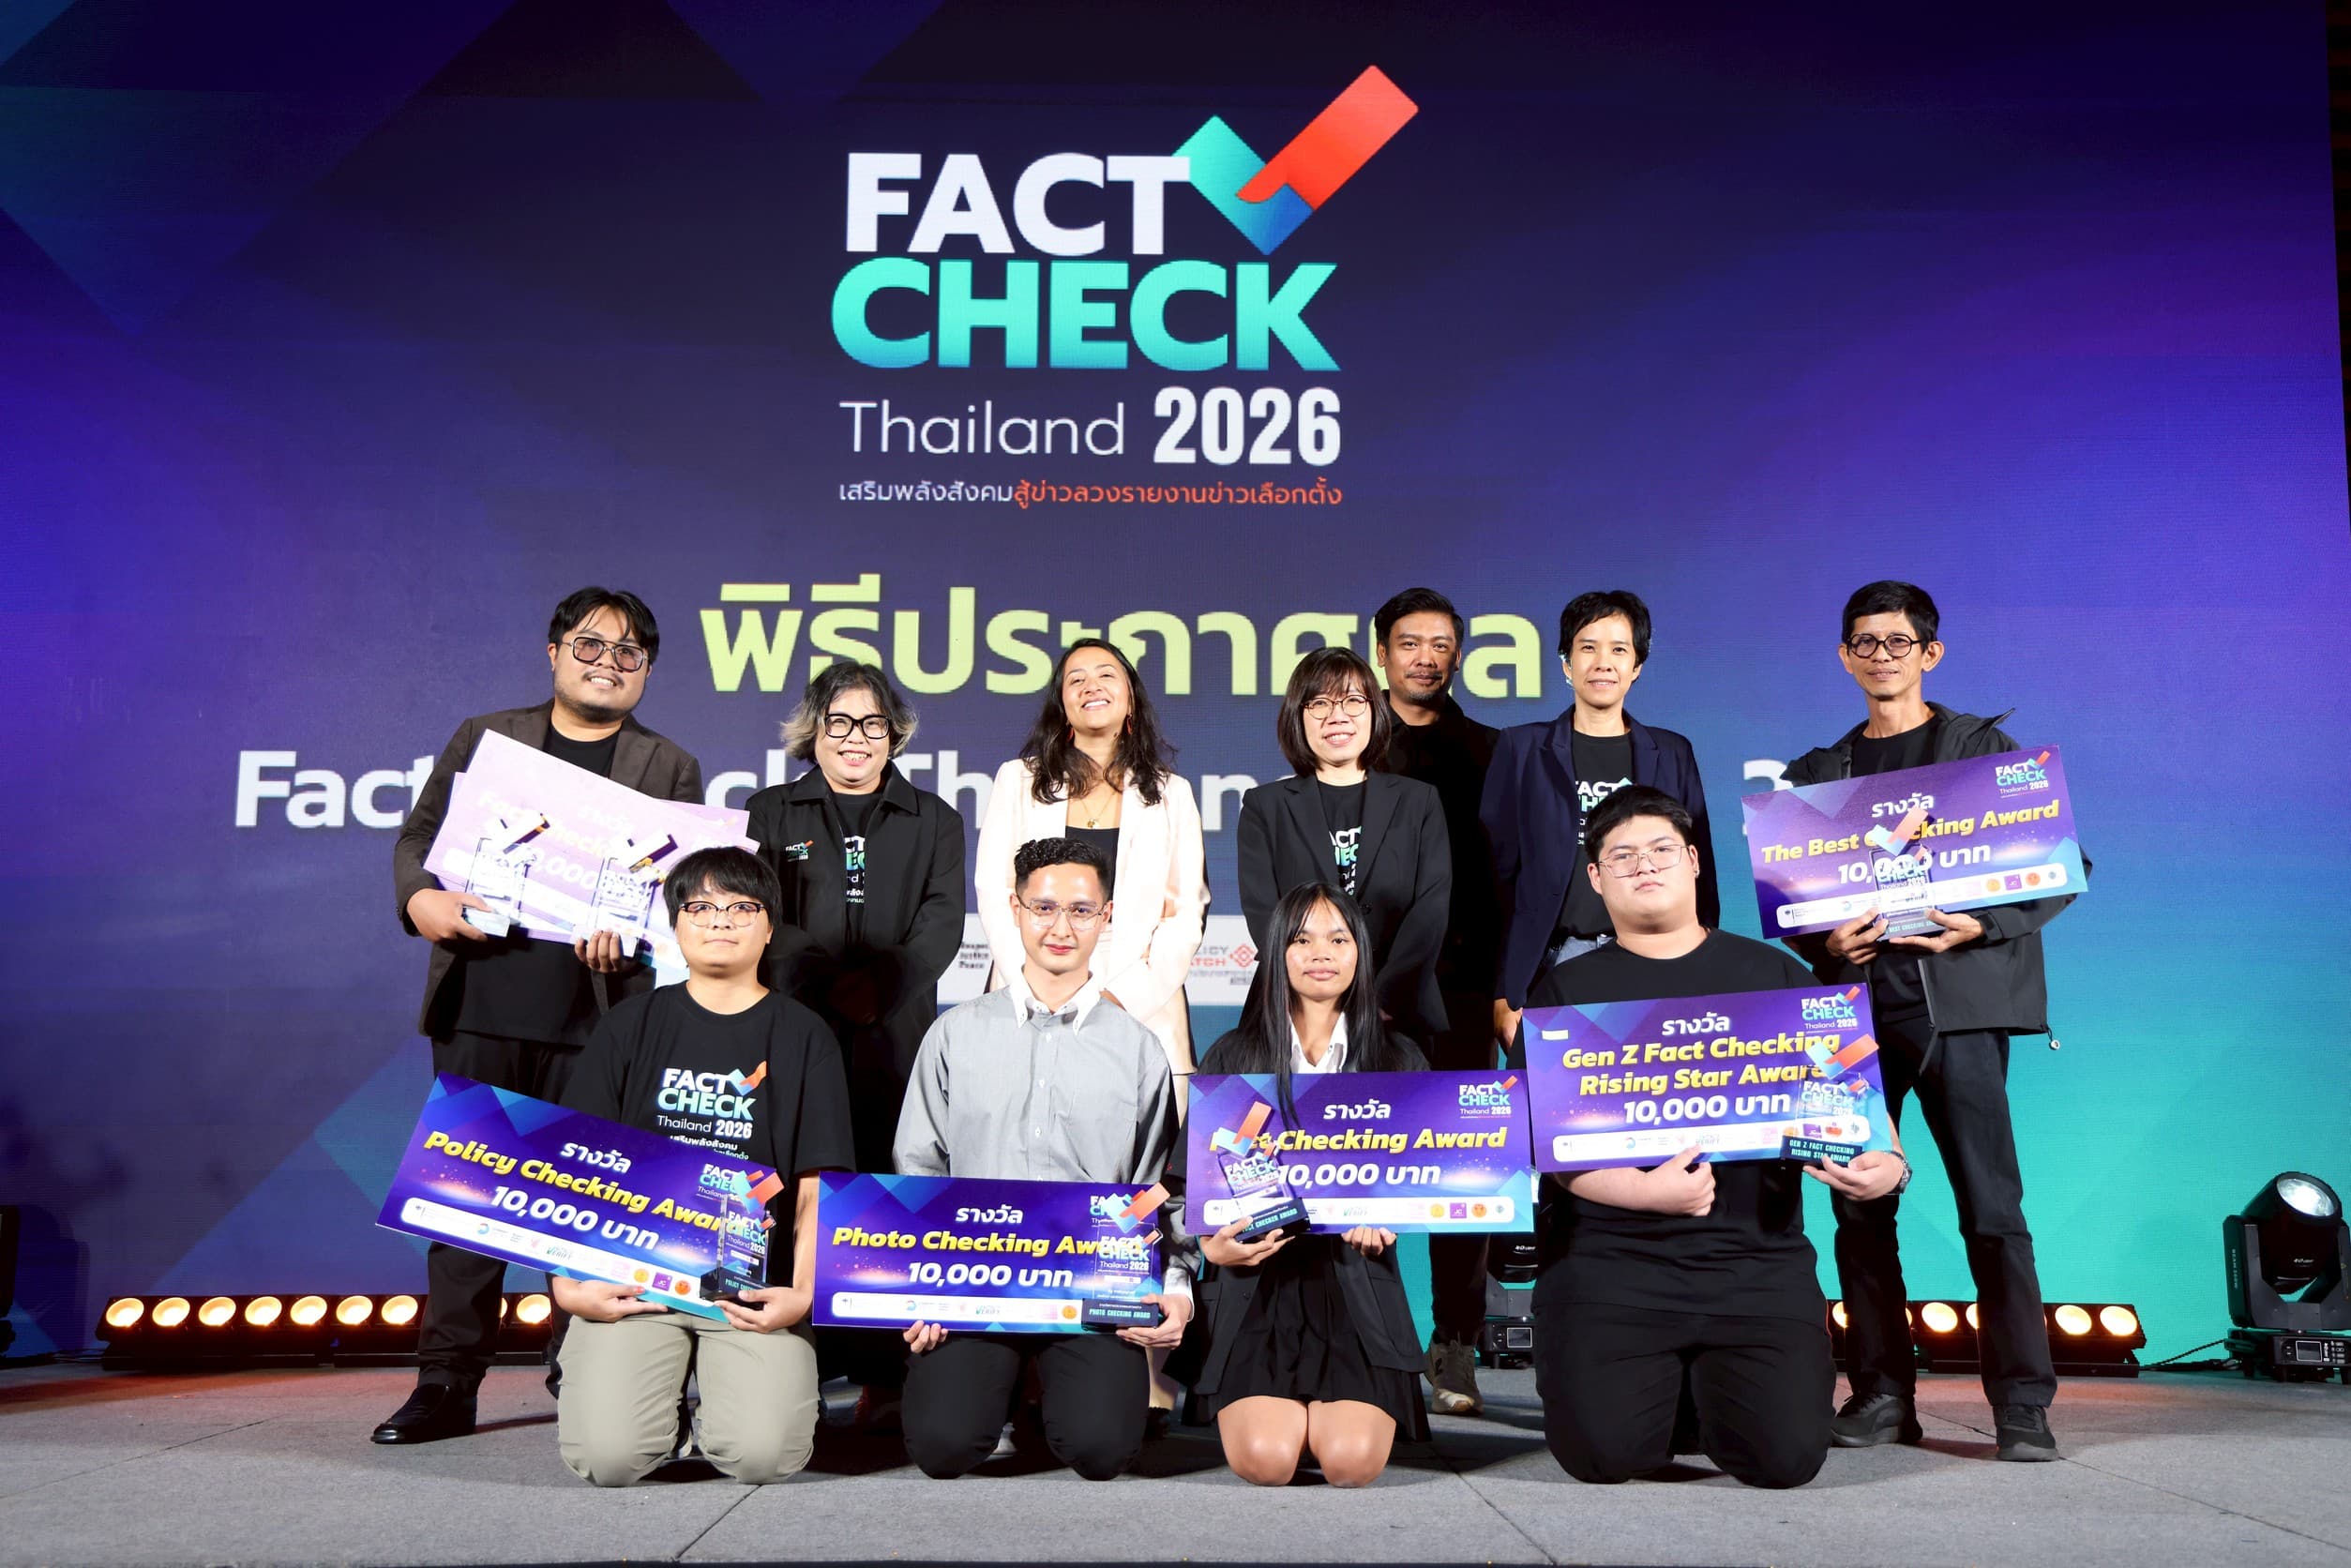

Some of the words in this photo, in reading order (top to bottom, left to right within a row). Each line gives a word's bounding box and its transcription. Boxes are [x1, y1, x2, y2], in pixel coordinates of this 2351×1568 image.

[846, 153, 1191, 256] FACT
[831, 257, 1341, 371] CHECK
[839, 400, 1124, 456] Thailand
[1153, 385, 1341, 466] 2026
[700, 573, 1542, 699] พิธีปรกาศล
[1996, 762, 2028, 776] FACT
[1997, 769, 2046, 787] CHECK
[1575, 780, 1620, 796] ACT
[2000, 785, 2027, 794] Thailand
[1871, 792, 1935, 818] รางวัล
[1329, 826, 1362, 849] CT
[1761, 844, 1803, 864] The
[1808, 834, 1860, 857] Best
[1863, 816, 1975, 847] Cking
[1981, 799, 2059, 830] Award
[1939, 844, 1991, 868] บาท
[1191, 957, 1227, 967] TCH
[1801, 996, 1837, 1010] FACT
[1801, 1005, 1856, 1021] CHECK
[1662, 1011, 1730, 1037] รางวัล
[1804, 1021, 1836, 1030] Thailand
[1836, 1018, 1858, 1028] 2026
[1562, 1048, 1615, 1070] Gen
[1620, 1045, 1638, 1065] Z
[1644, 1040, 1704, 1063] Fact
[662, 1068, 731, 1094] FACT
[1459, 1084, 1494, 1095] FACT
[1579, 1072, 1668, 1096] Rising
[1673, 1067, 1731, 1089] Star
[1803, 1080, 1840, 1094] FACT
[657, 1088, 757, 1121] CHECK
[1323, 1098, 1391, 1120] รางวัล
[1458, 1094, 1511, 1106] CHECK
[1491, 1107, 1511, 1115] 2026
[1623, 1095, 1727, 1125] 10,000
[1735, 1093, 1791, 1116] บาท
[657, 1115, 712, 1133] Thailand
[715, 1120, 753, 1138] 2026
[1278, 1128, 1409, 1154] Checking
[1413, 1127, 1508, 1150] Award
[561, 1140, 632, 1173] รางวัล
[424, 1130, 518, 1175] Policy
[520, 1160, 650, 1214] Checking
[703, 1163, 737, 1180] FACT
[1277, 1164, 1379, 1189] 10,000
[1385, 1166, 1440, 1186] บาท
[700, 1174, 736, 1194] CHE
[490, 1185, 598, 1232] 10,000
[601, 1217, 660, 1250] บาท
[956, 1204, 1024, 1225] รางวัล
[728, 1234, 749, 1248] Thailand
[833, 1228, 916, 1248] Photo
[922, 1230, 1050, 1257] Checking
[907, 1261, 1012, 1288] 10,000
[1018, 1269, 1073, 1288] บาท
[1100, 1260, 1128, 1269] Thailand
